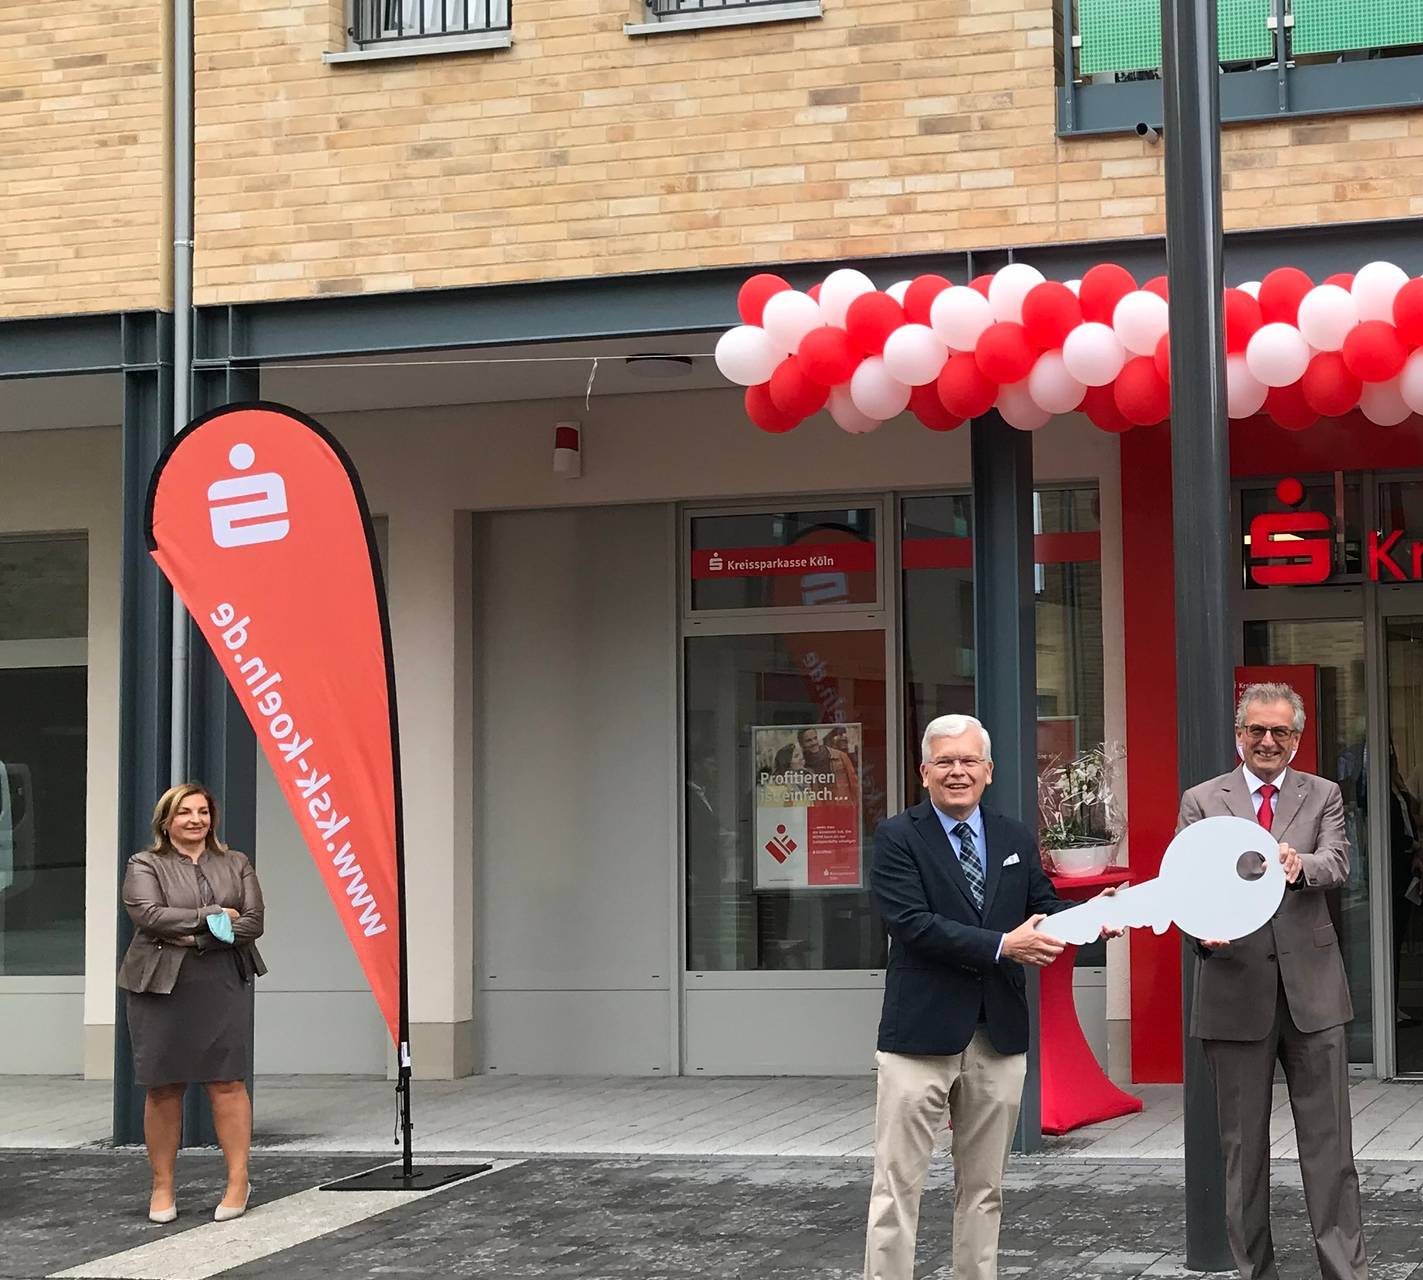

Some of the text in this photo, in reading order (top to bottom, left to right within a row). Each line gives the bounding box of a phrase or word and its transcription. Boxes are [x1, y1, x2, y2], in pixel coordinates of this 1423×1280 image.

[727, 558, 808, 571] Kreissparkasse
[809, 555, 834, 567] Köln
[760, 771, 835, 785] Profitieren
